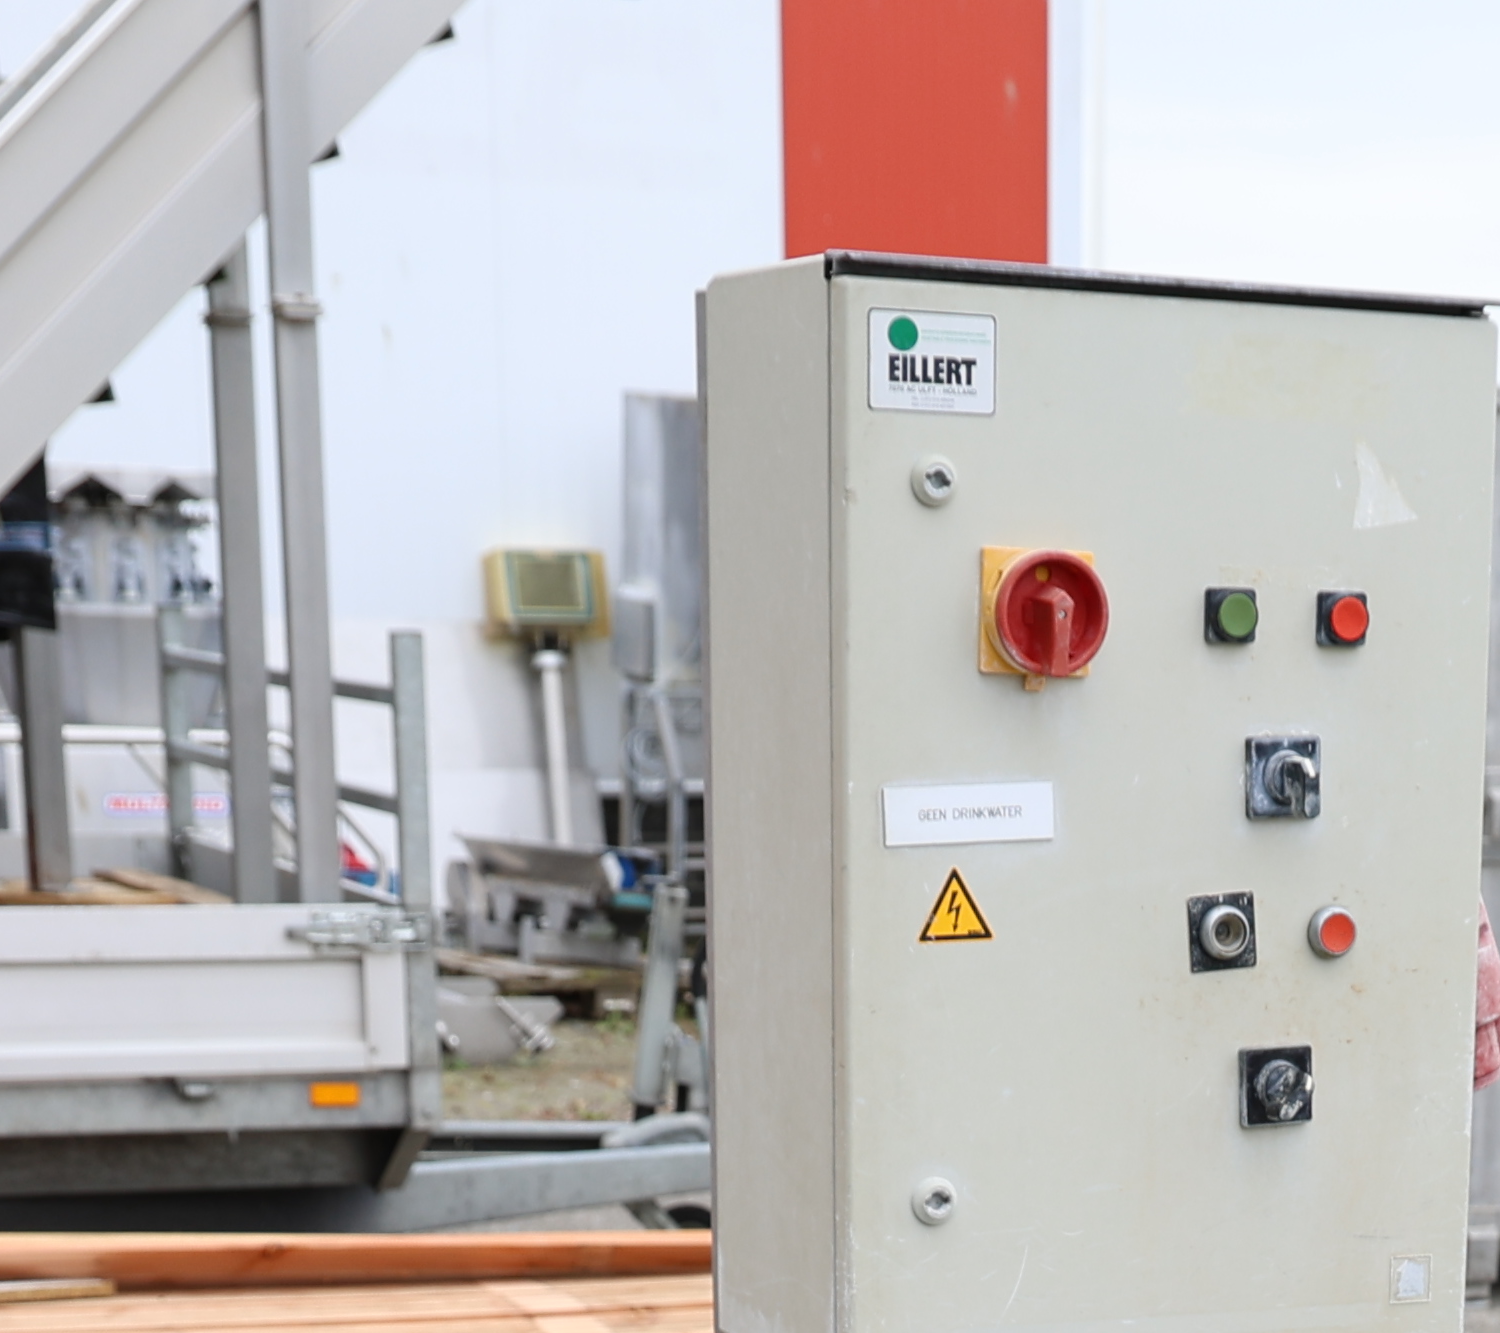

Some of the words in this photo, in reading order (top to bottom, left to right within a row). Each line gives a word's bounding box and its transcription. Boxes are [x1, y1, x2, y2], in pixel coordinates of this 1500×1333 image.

[888, 353, 977, 386] EILLERT
[943, 385, 977, 395] HOLLAND
[918, 808, 947, 822] GEEN
[952, 805, 1023, 820] DRINKWATER
